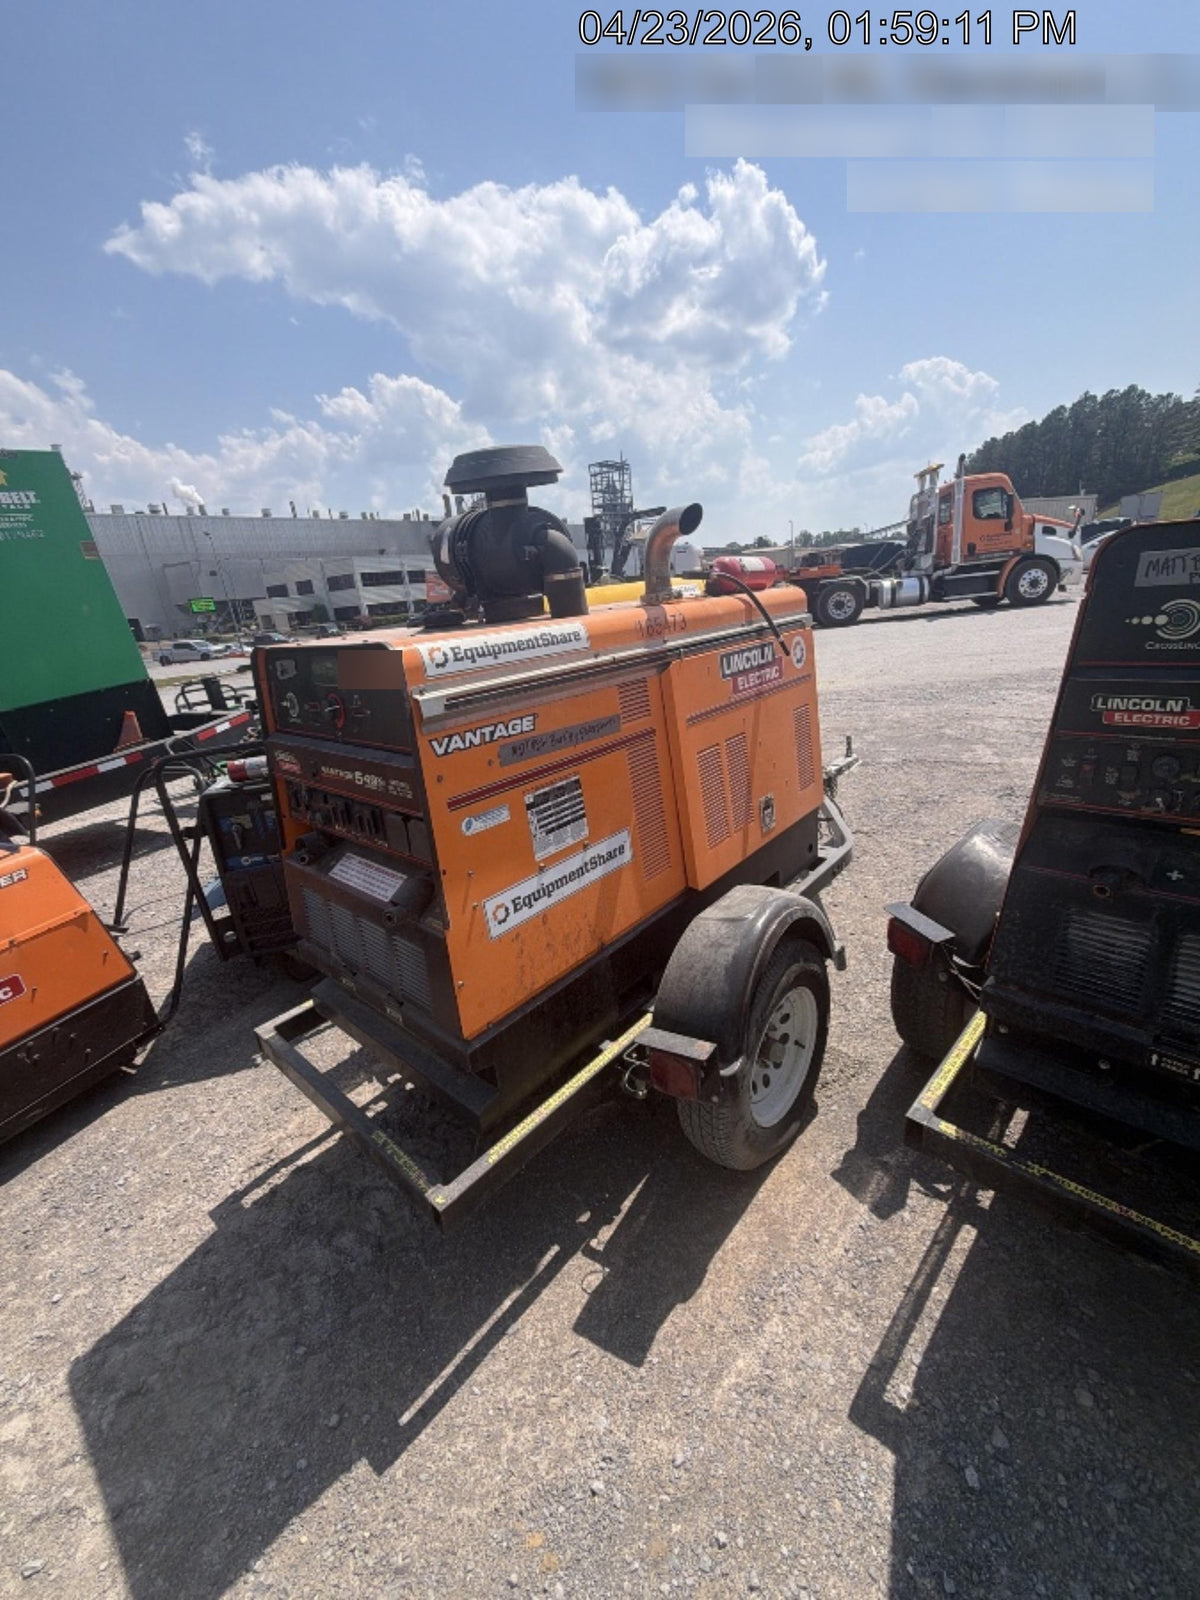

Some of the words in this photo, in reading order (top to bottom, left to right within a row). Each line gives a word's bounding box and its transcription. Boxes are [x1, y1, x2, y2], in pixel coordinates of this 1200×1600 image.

[1145, 556, 1186, 578] MATT
[451, 629, 582, 664] EquipmentShare
[721, 644, 774, 675] LINCOLN
[736, 664, 780, 690] ELECTRIC
[1096, 697, 1184, 713] LINCOLN
[1113, 712, 1191, 726] ELECTRIC
[429, 714, 536, 757] VANTAGE
[511, 842, 625, 914] EquipmentShare
